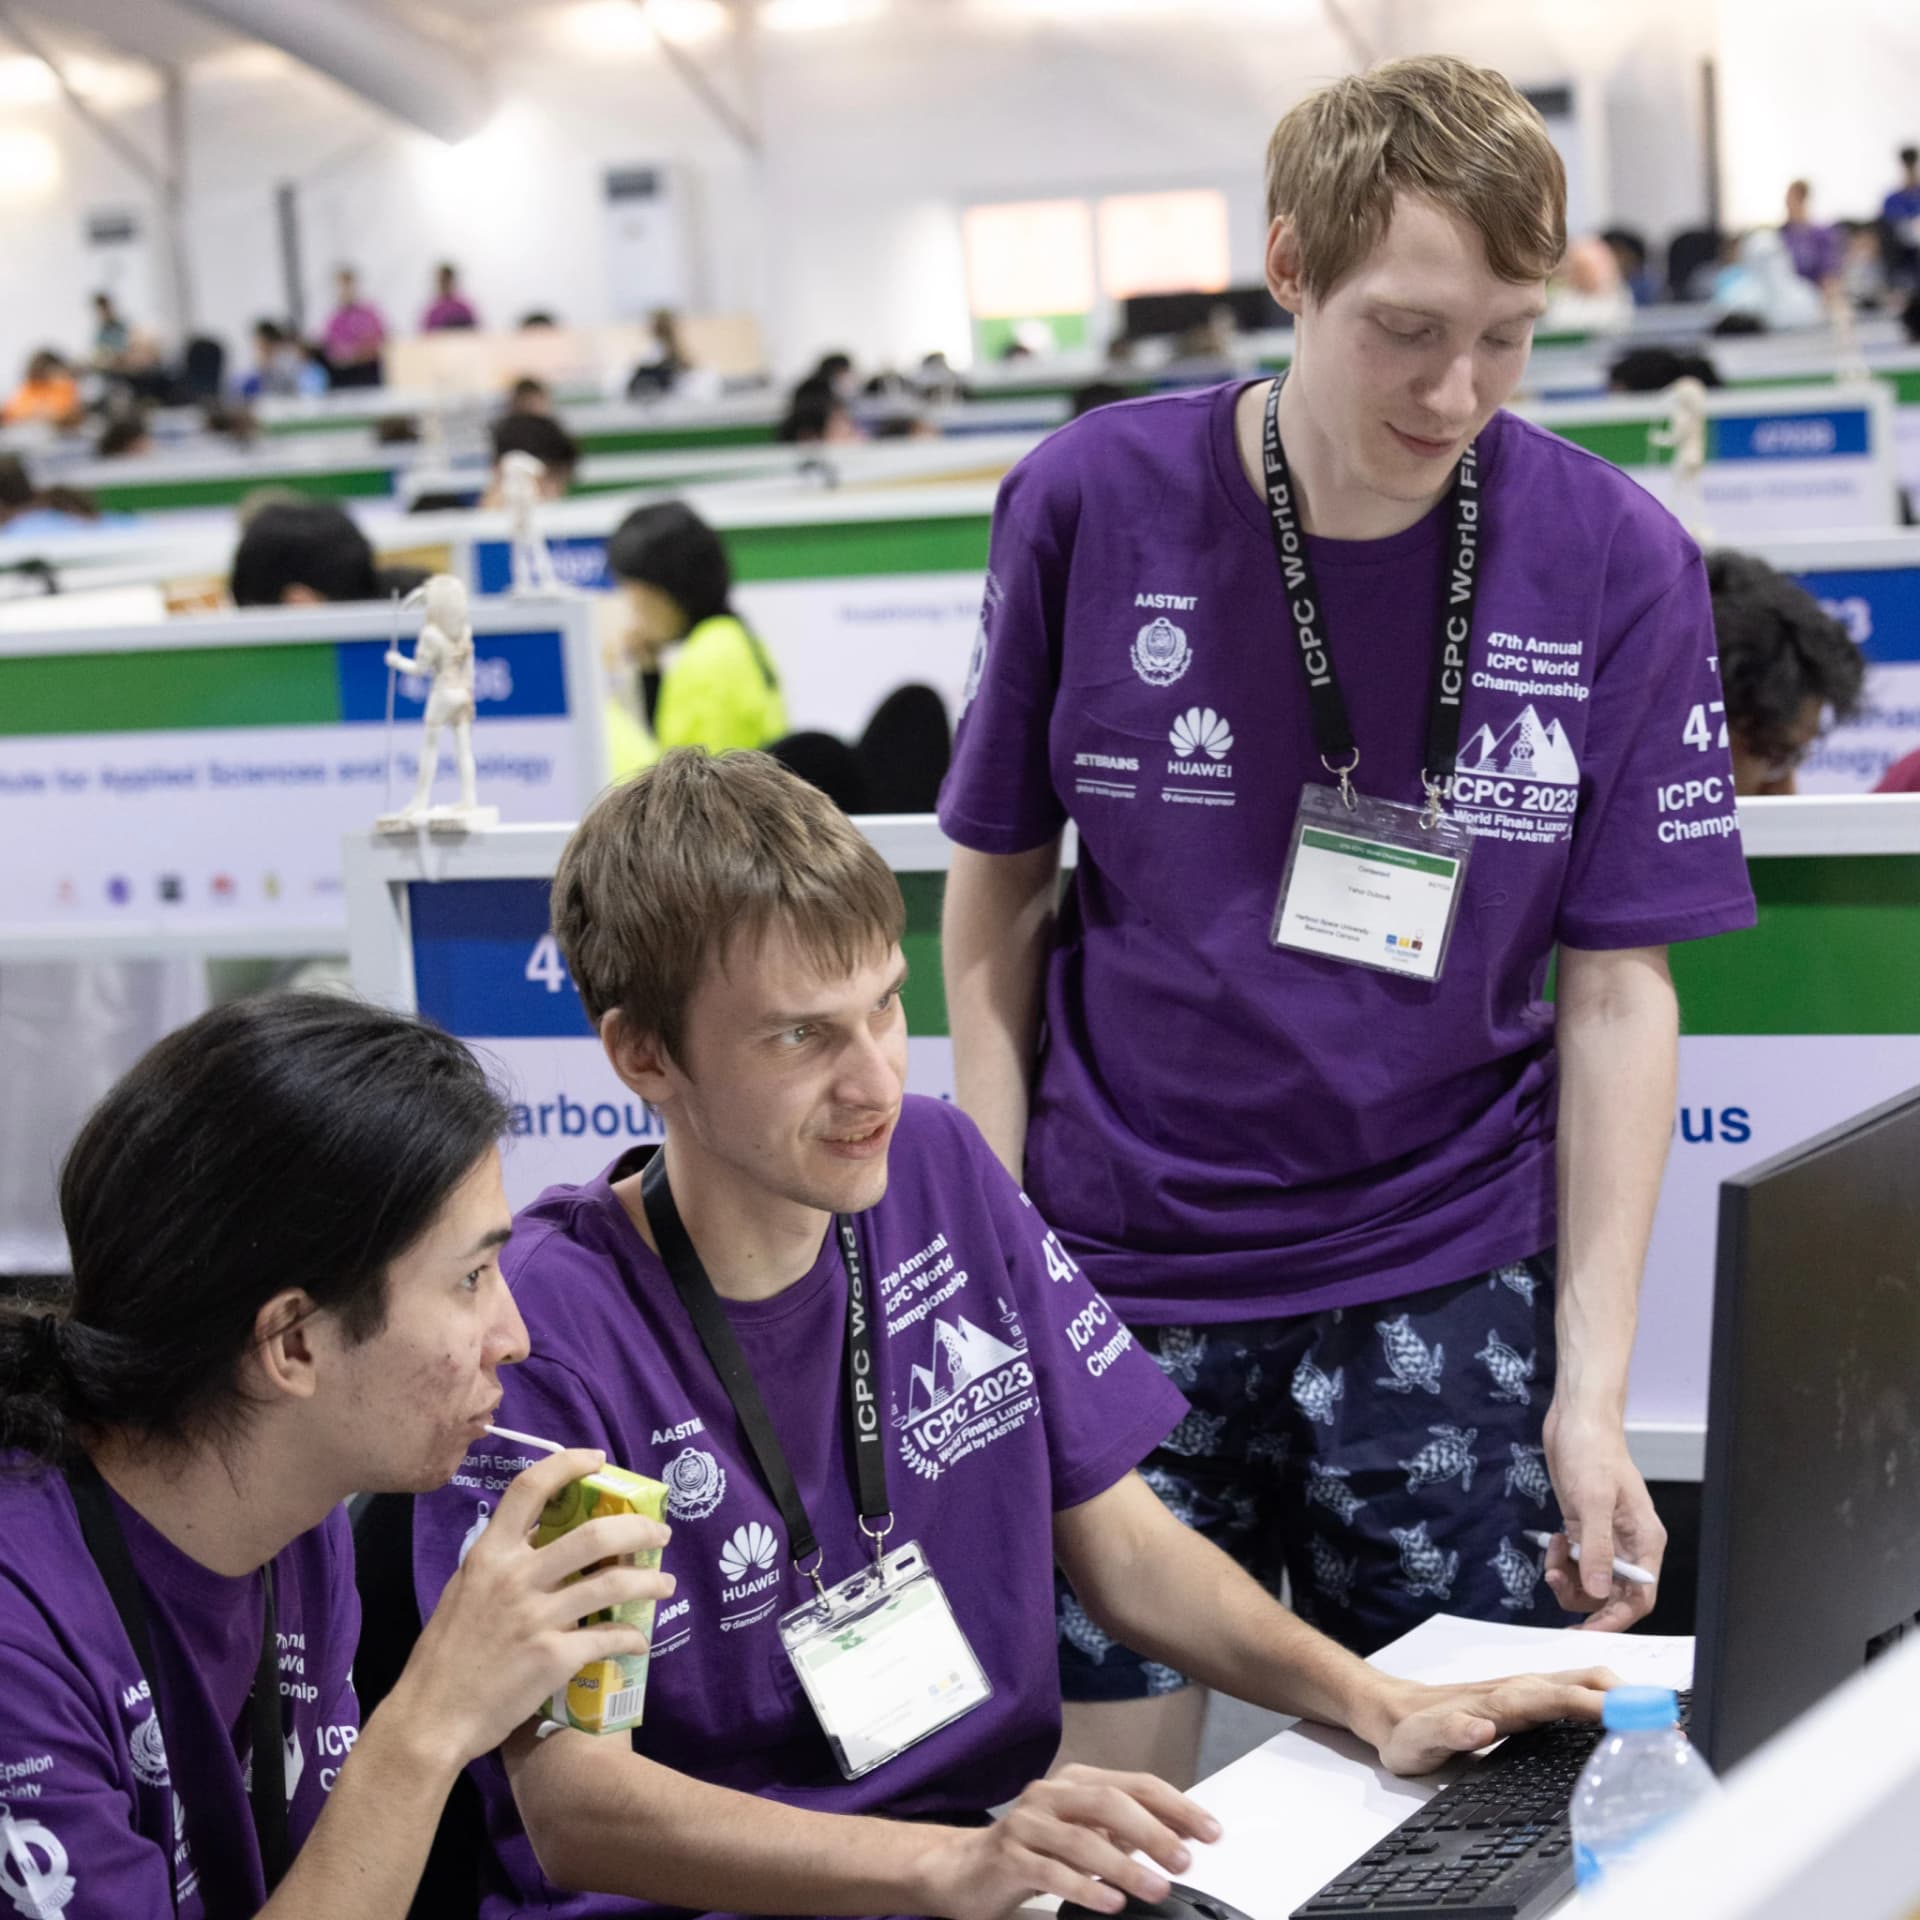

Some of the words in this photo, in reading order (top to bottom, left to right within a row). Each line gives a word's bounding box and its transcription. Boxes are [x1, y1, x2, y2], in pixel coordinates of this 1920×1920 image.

[1269, 484, 1306, 589] World
[1450, 500, 1478, 604] World
[1134, 593, 1198, 611] AASTMT
[1292, 598, 1331, 687] ICPC
[1440, 616, 1468, 706] ICPC
[1487, 632, 1523, 651] 47th
[1525, 637, 1583, 656] Annual
[1487, 653, 1528, 673] ICPC
[1532, 658, 1579, 677] World
[1471, 672, 1590, 702] Championship
[1167, 760, 1233, 778] HUAWEI
[1443, 776, 1516, 808] ICPC
[1521, 785, 1578, 813] 2023
[1657, 777, 1724, 812] ICPC
[1453, 809, 1492, 825] World
[1494, 814, 1534, 830] Finals
[1536, 819, 1569, 832] Luxor
[1501, 829, 1515, 842] by
[898, 1232, 948, 1279] Annual
[909, 1253, 954, 1292] World
[843, 1227, 866, 1337] World
[1065, 1299, 1107, 1353] ICPC
[854, 1349, 878, 1442] ICPC
[912, 1397, 969, 1451] ICPC
[968, 1361, 1034, 1412] 2023
[960, 1416, 998, 1442] Finals
[996, 1396, 1034, 1423] Luxor
[480, 1455, 493, 1468] Pi
[722, 1568, 780, 1603] HUAWEI
